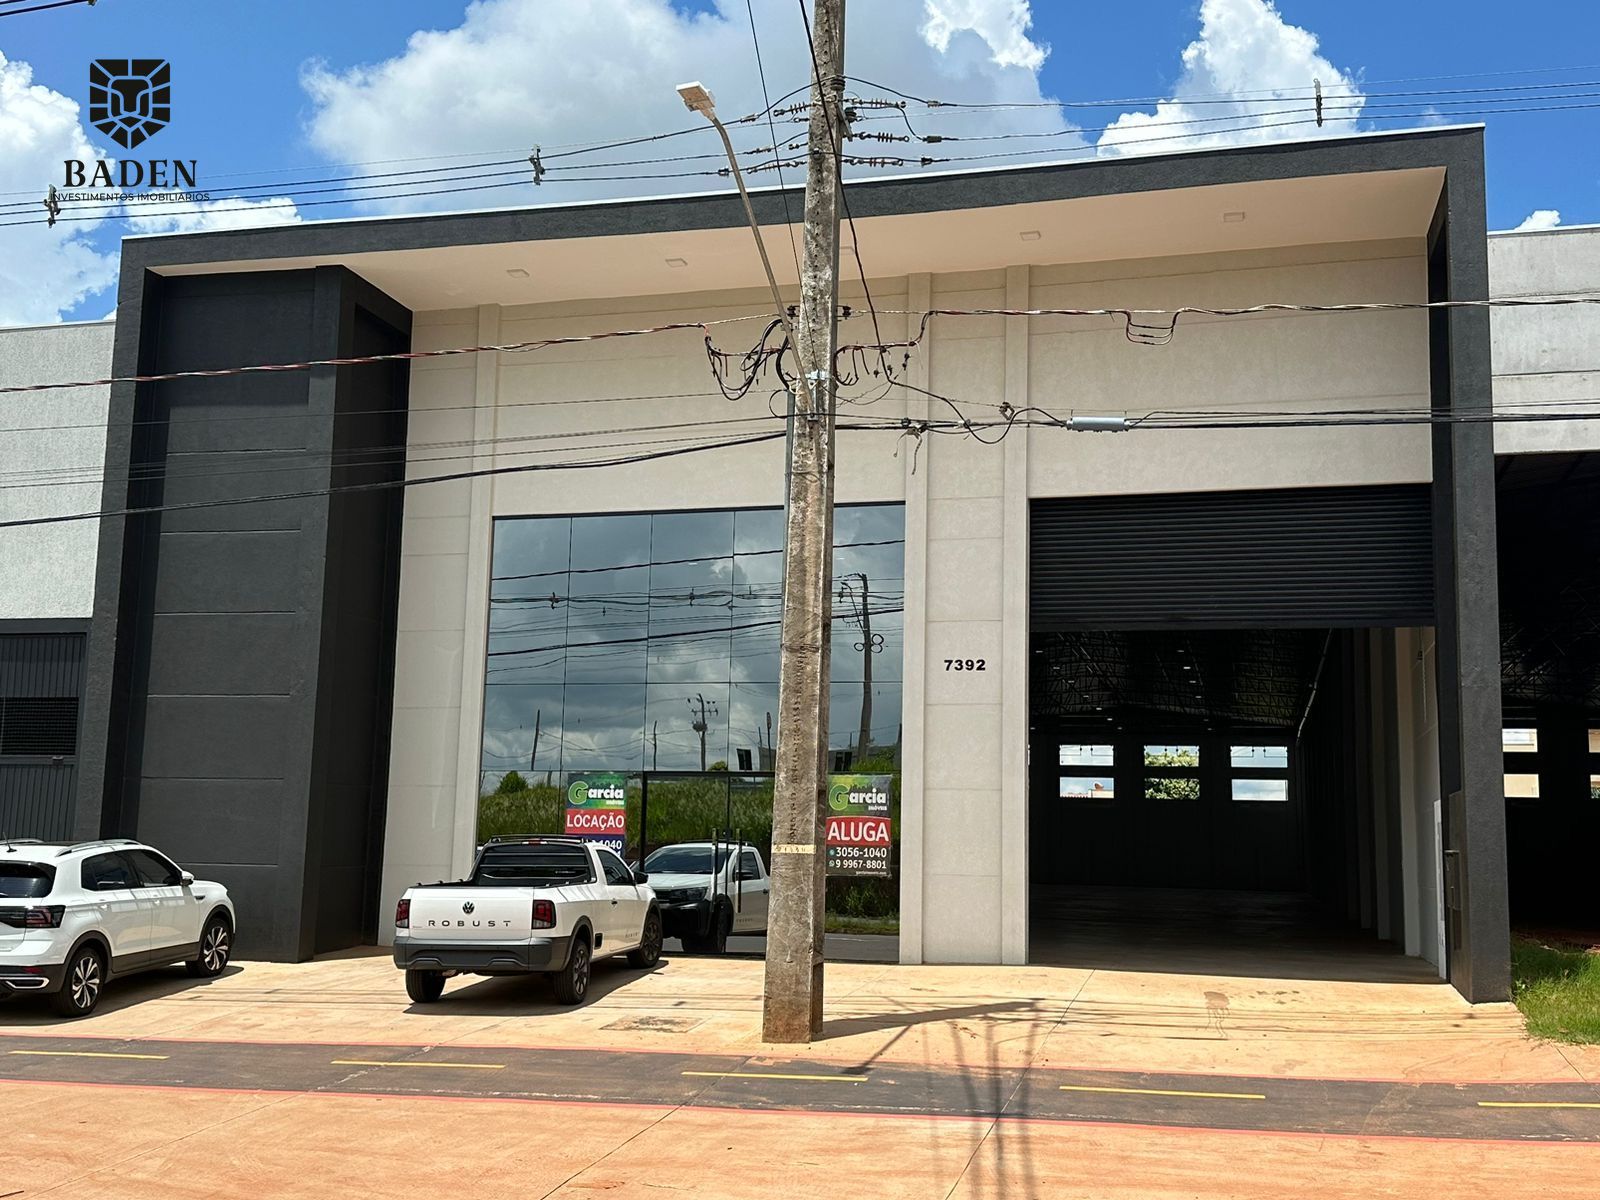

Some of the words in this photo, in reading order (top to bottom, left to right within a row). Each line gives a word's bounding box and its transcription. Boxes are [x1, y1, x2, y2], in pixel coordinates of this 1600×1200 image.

[943, 659, 986, 671] 7392
[568, 780, 624, 805] Garcia
[829, 783, 887, 811] Garcia
[566, 811, 625, 831] LOCAÇÃO
[827, 821, 890, 842] ALUGA
[835, 846, 888, 858] 3056-1040
[835, 859, 841, 869] 9
[842, 859, 887, 869] 9967-8801
